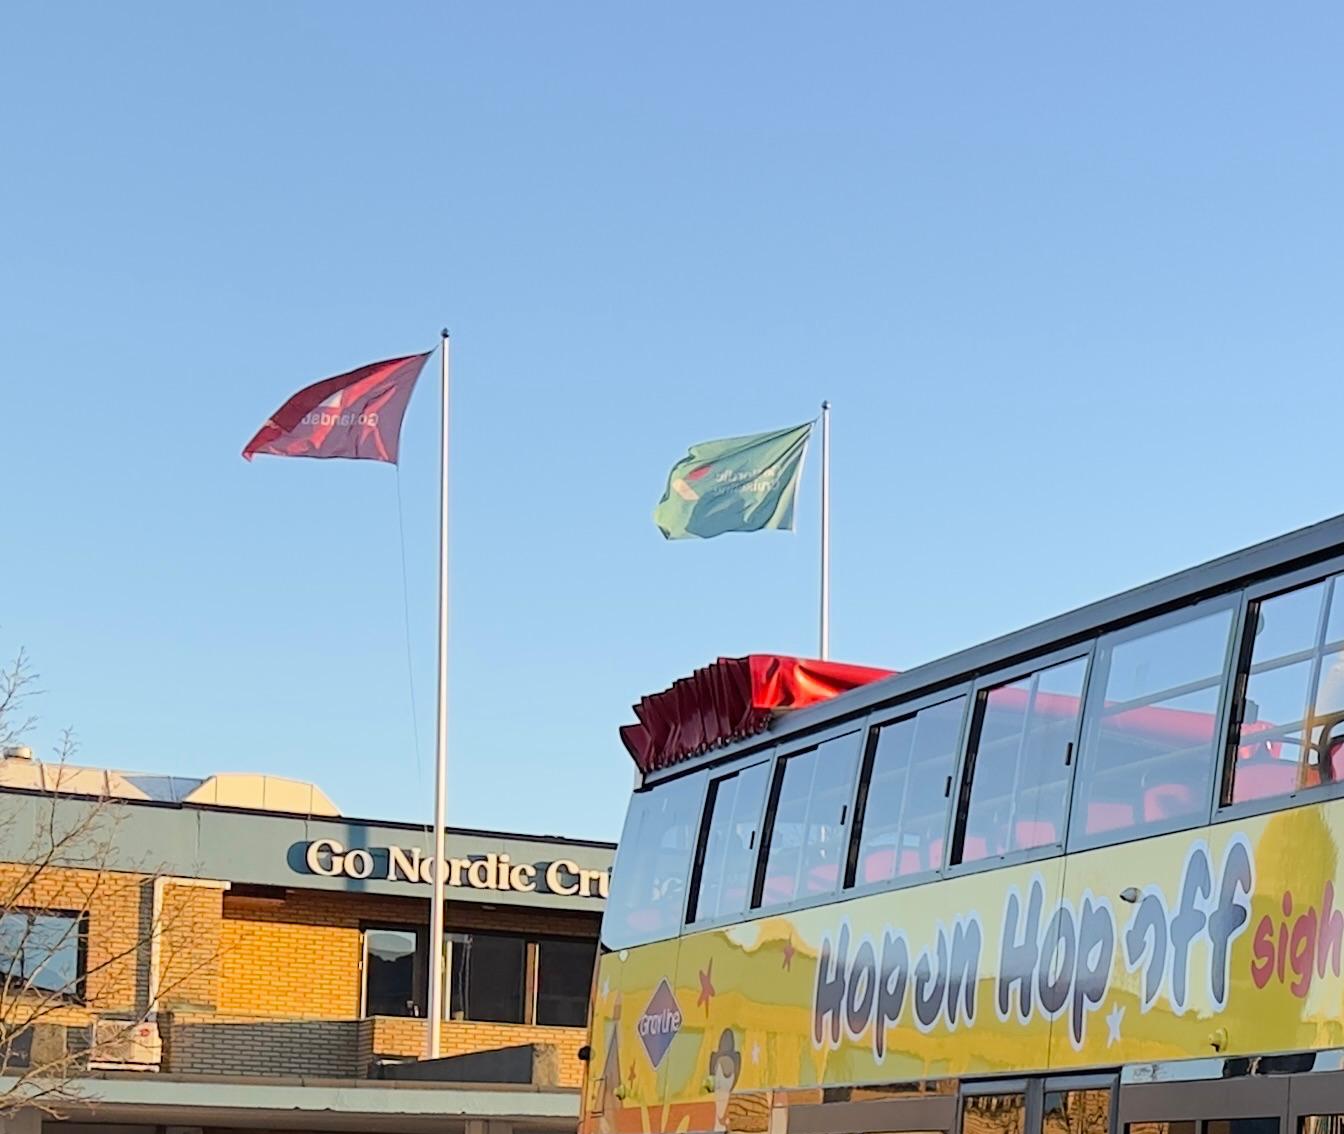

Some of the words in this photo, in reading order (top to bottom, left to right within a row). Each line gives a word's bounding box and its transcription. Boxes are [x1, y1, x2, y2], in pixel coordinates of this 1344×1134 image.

[306, 839, 374, 878] Go
[387, 845, 536, 892] Nordic
[812, 918, 911, 1066] Hop
[910, 912, 981, 1033] on
[996, 873, 1115, 1053] Hop
[1122, 833, 1257, 1016] off
